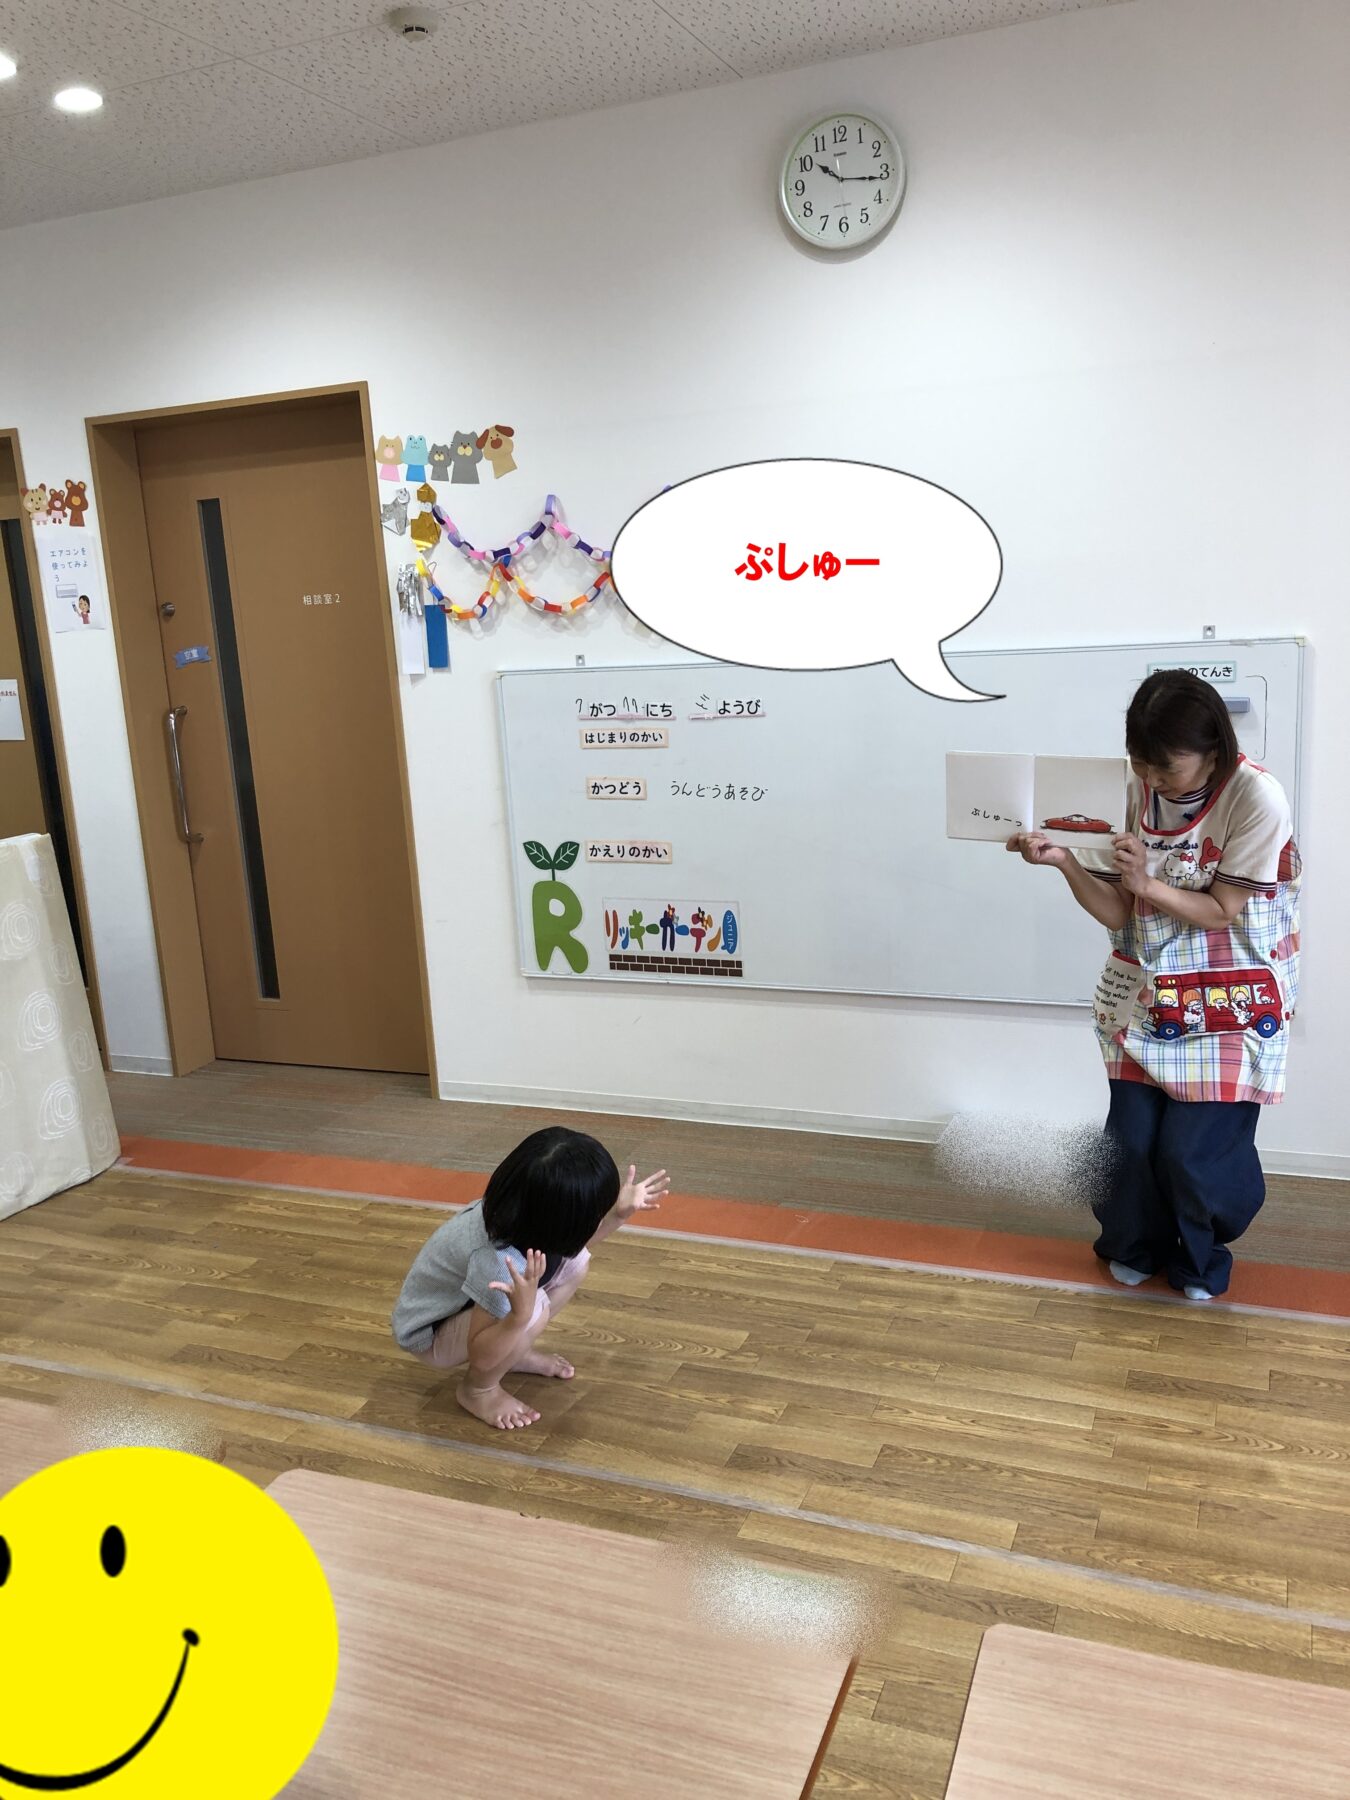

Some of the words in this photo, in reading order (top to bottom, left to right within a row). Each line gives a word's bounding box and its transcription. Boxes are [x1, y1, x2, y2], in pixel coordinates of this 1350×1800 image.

[832, 125, 848, 144] 12
[857, 127, 864, 144] 1
[814, 135, 827, 153] 11
[871, 140, 882, 158] 2
[798, 154, 813, 172] 10
[879, 163, 890, 180] 3
[794, 180, 805, 196] 9
[873, 189, 883, 204] 4
[803, 201, 813, 217] 8
[859, 207, 869, 223] 5
[820, 215, 829, 231] 7
[838, 216, 850, 233] 6
[50, 547, 86, 558] エアコンを
[1153, 667, 1233, 679] のてんき
[585, 731, 663, 744] はじまりのかい
[591, 781, 642, 795] かつどう
[589, 844, 668, 859] かえりのかい
[531, 880, 589, 974] R
